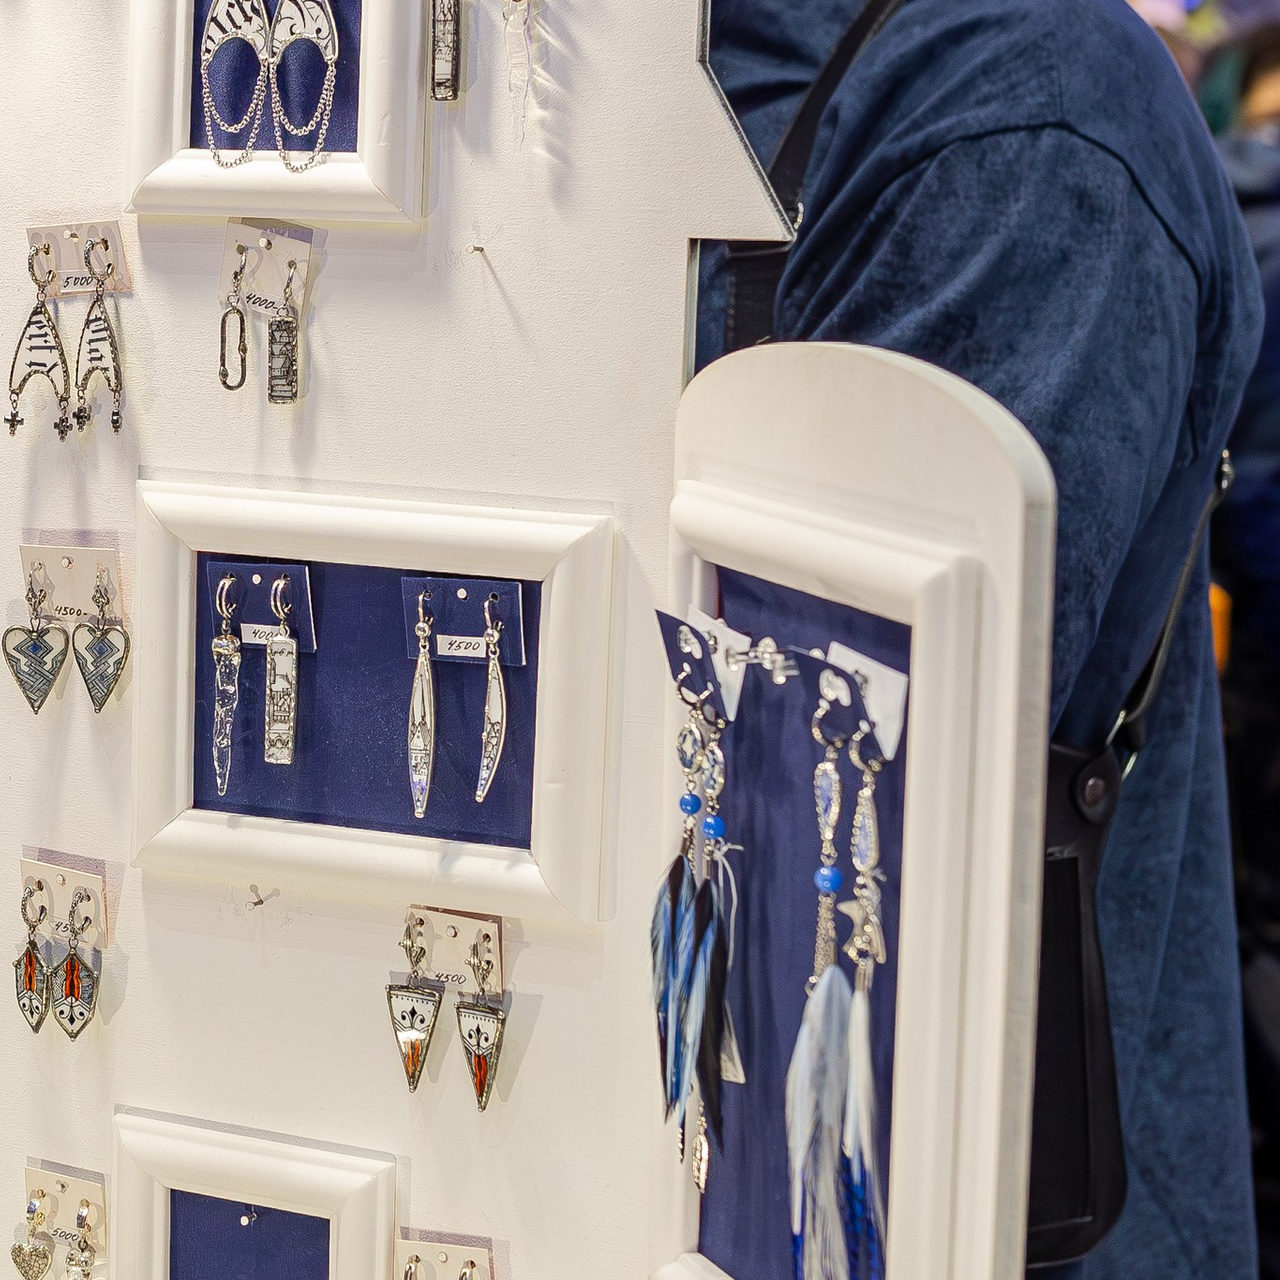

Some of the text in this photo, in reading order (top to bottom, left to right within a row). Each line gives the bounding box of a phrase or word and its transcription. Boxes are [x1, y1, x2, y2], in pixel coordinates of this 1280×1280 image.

[447, 638, 481, 651] 4500
[435, 972, 466, 985] 4500
[51, 1227, 80, 1241] 5000
